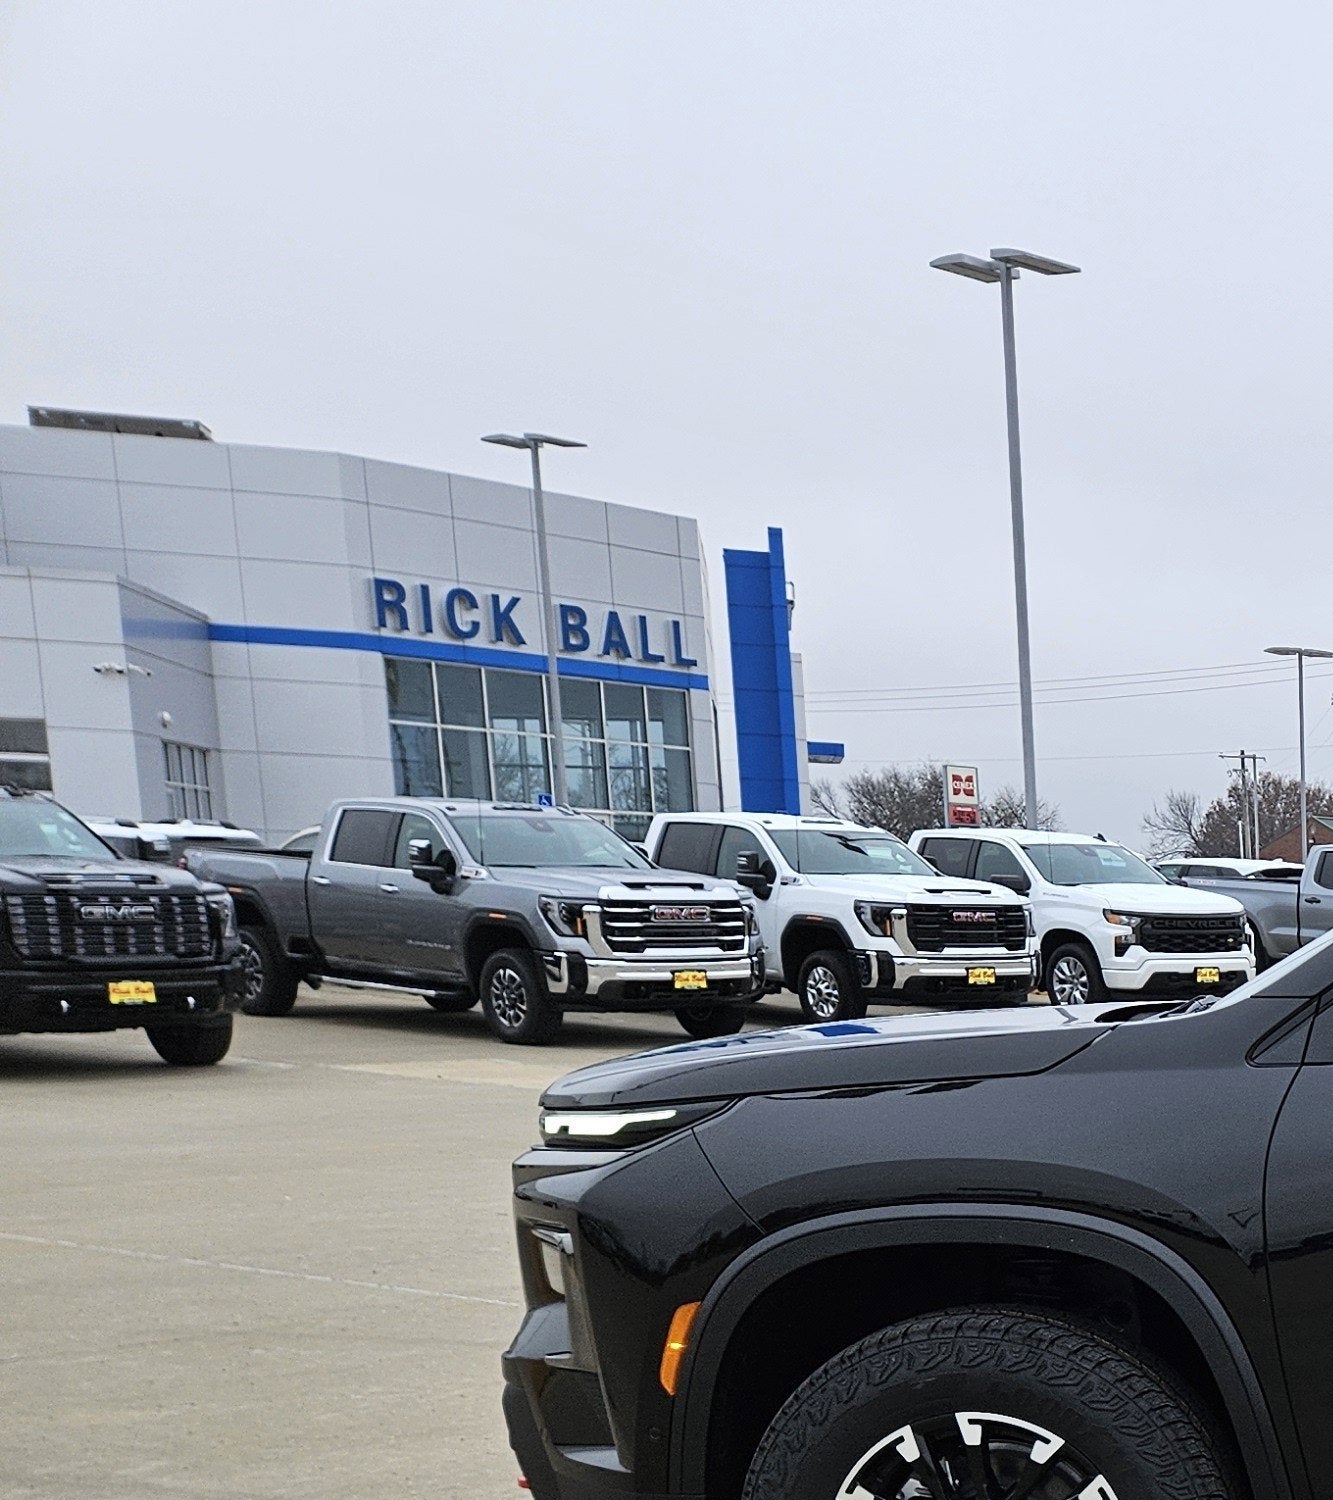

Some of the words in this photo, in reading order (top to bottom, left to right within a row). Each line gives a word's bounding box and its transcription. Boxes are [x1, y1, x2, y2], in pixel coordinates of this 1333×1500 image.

[372, 577, 528, 646] RICK
[558, 603, 698, 667] BALL
[81, 905, 155, 920] GMC
[654, 906, 708, 921] GMC
